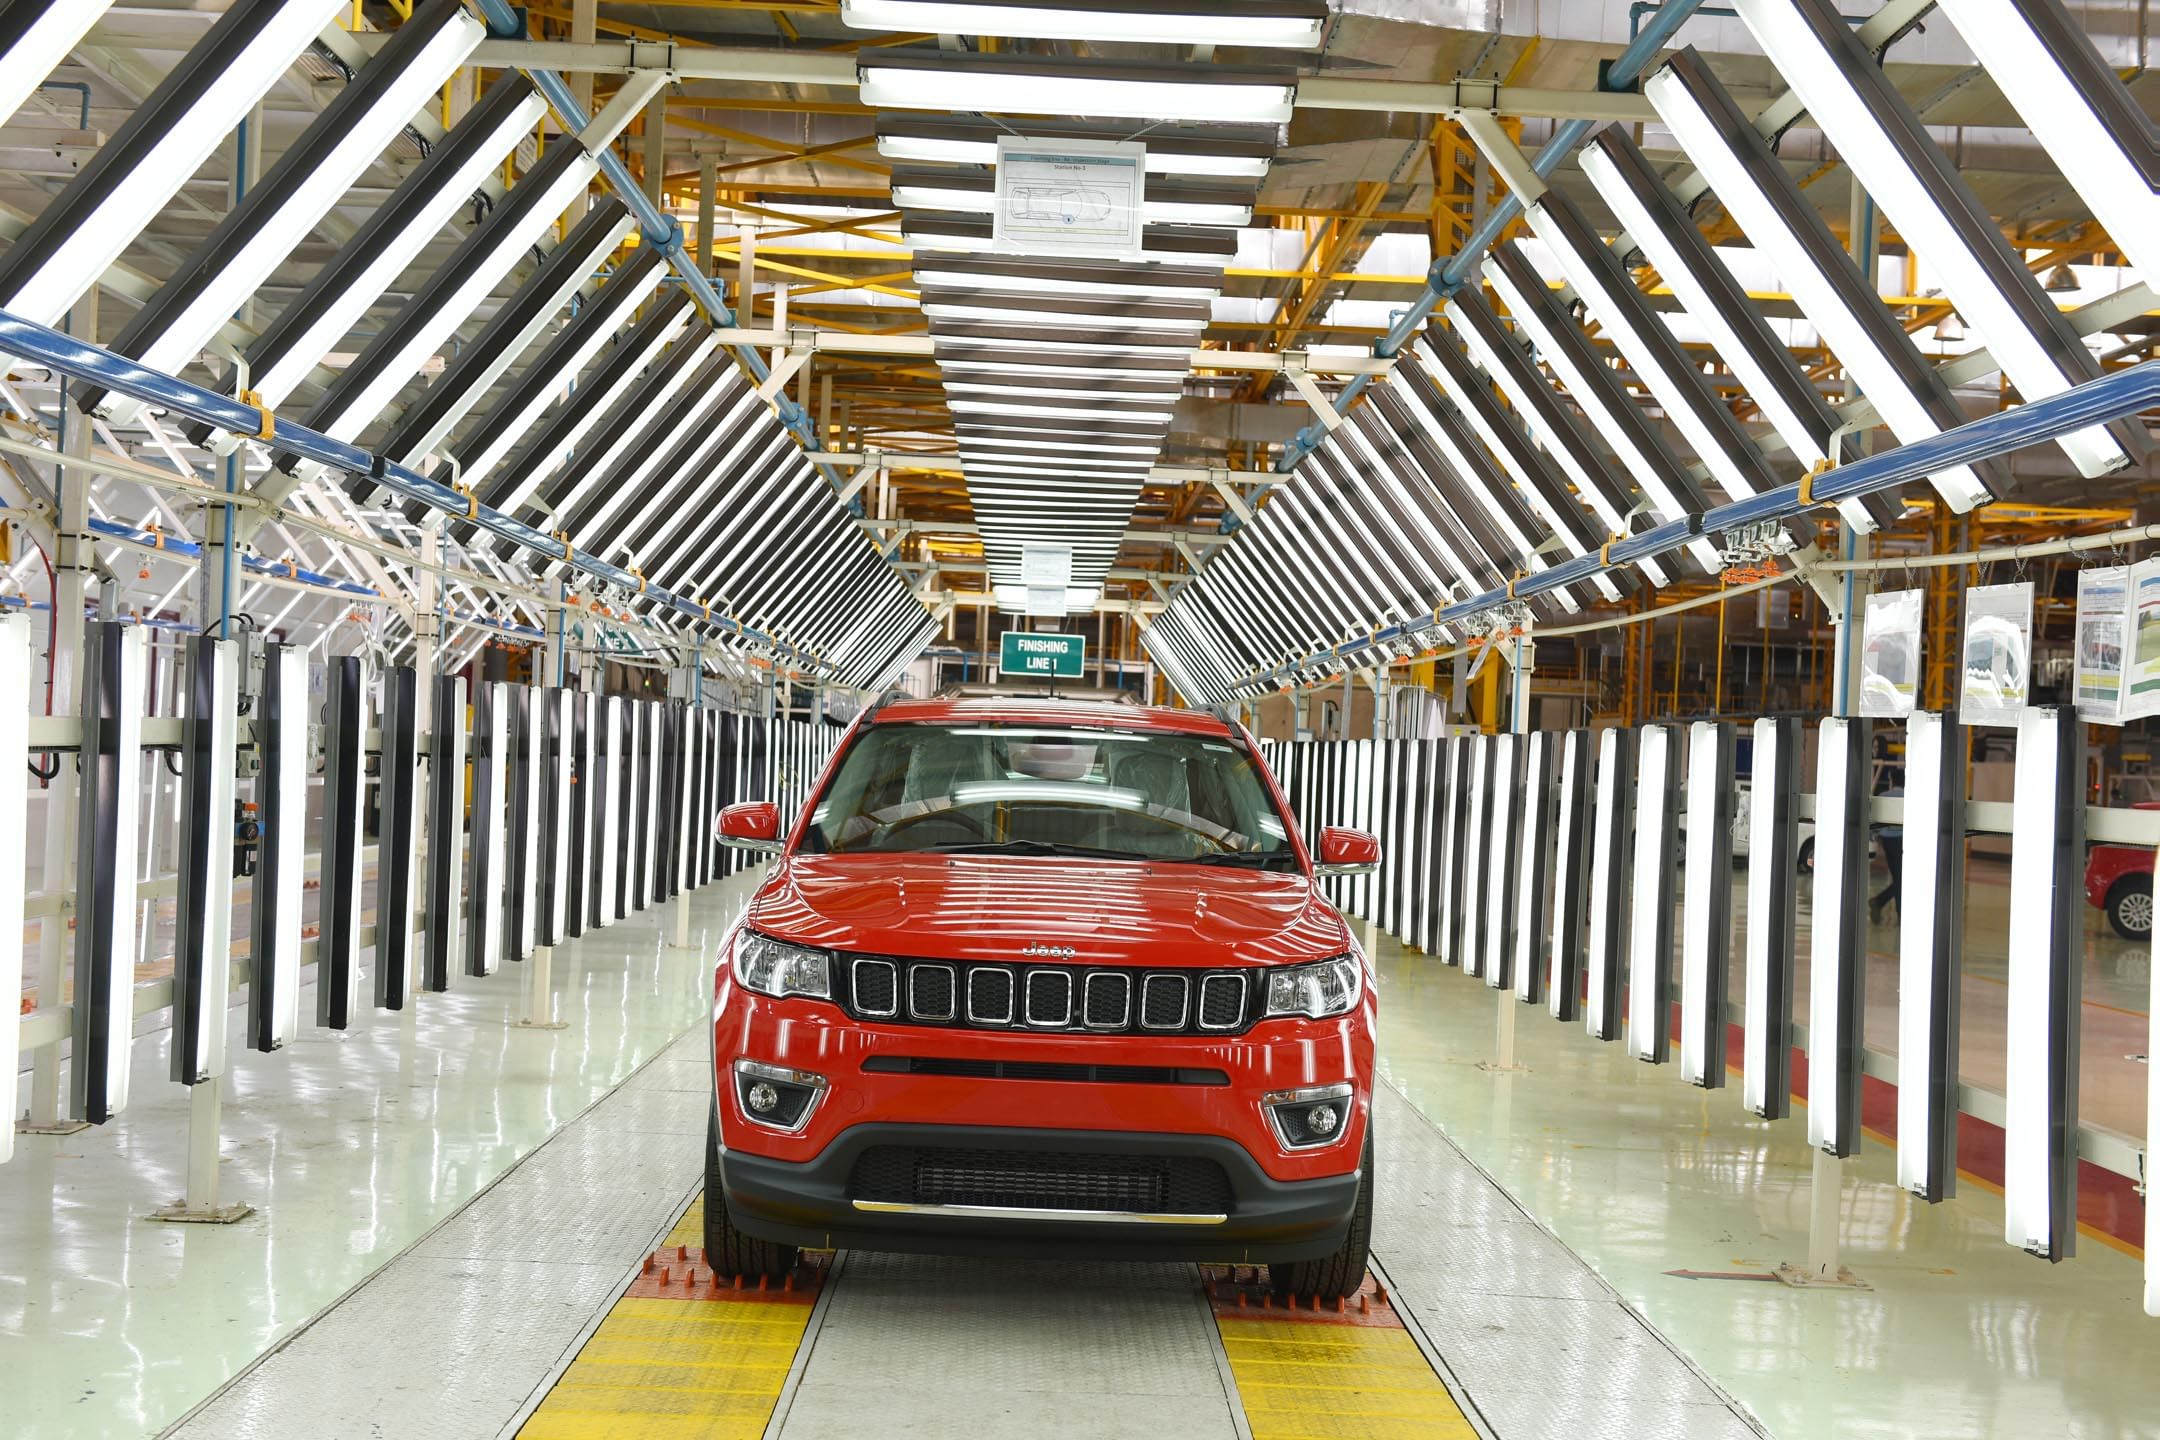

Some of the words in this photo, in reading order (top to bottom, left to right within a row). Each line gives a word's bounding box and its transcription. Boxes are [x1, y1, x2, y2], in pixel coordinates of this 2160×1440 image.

[1018, 639, 1069, 654] FINISHING
[1026, 656, 1050, 670] LINE
[1053, 658, 1058, 670] 1
[1022, 941, 1075, 960] Jeep
